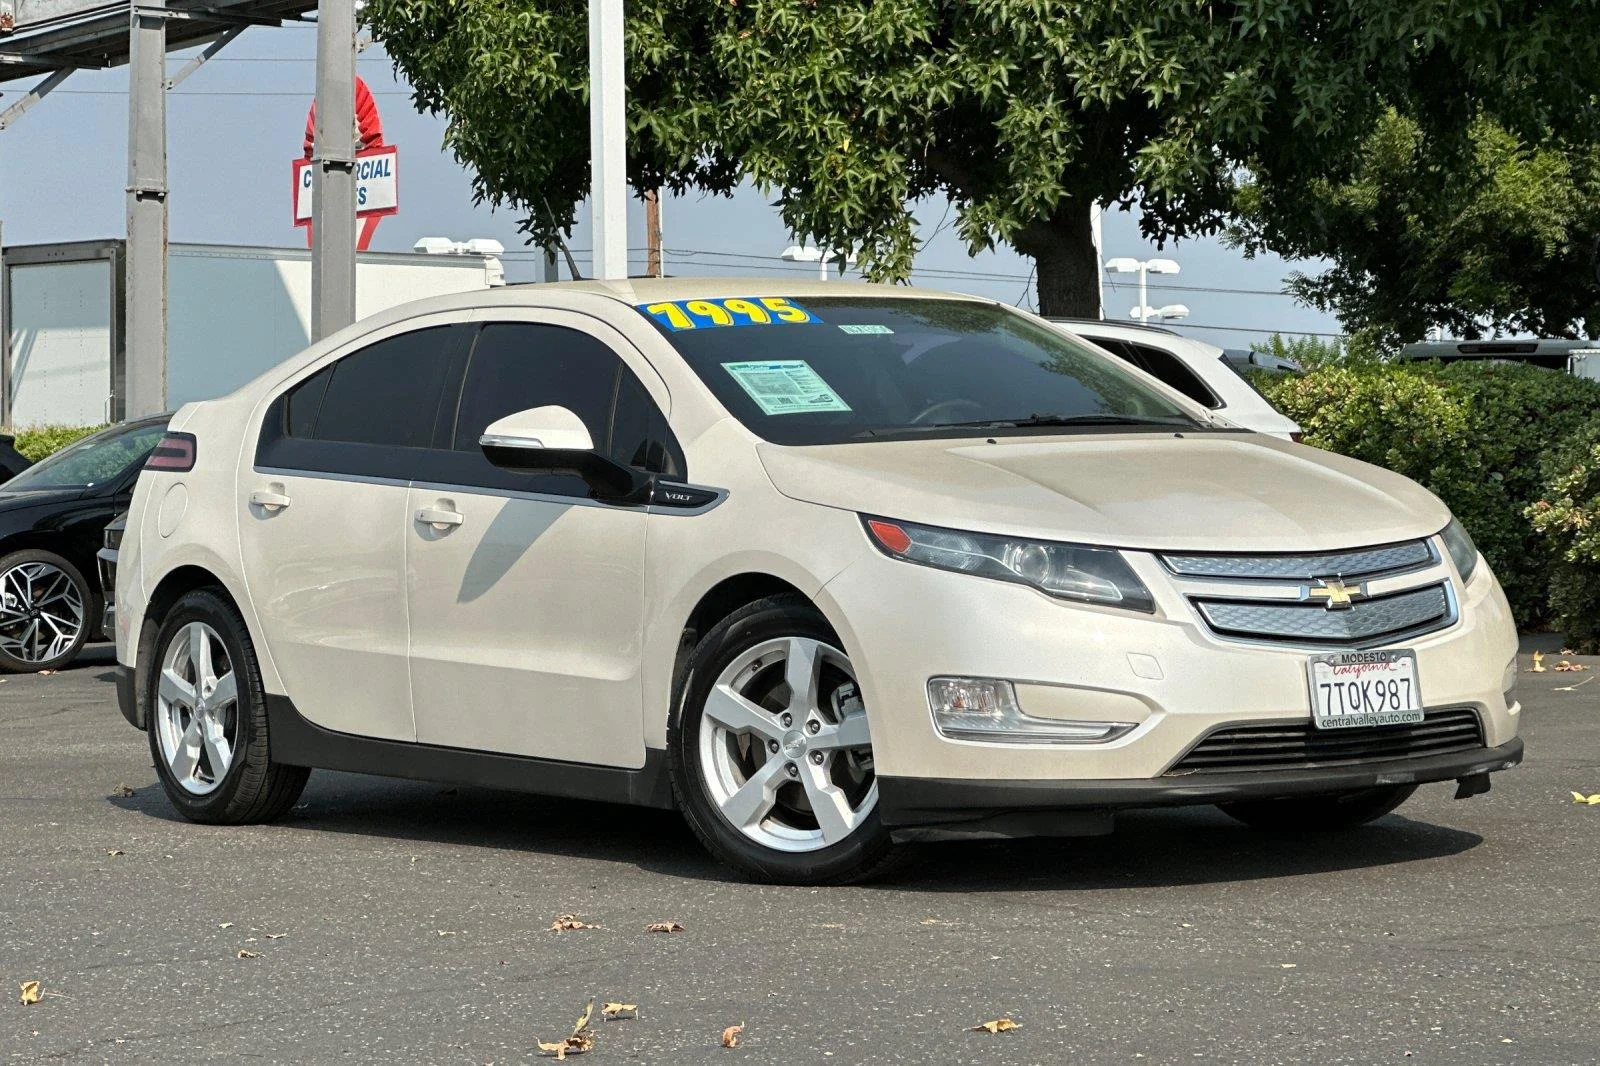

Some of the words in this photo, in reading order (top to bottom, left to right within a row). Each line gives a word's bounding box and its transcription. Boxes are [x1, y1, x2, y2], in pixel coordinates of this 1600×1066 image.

[647, 298, 811, 328] 7995
[665, 491, 692, 501] VOLT
[1341, 652, 1387, 664] MODESTO
[1320, 678, 1410, 716] 7TQK987
[1322, 713, 1420, 728] centralvalleyauto.com
